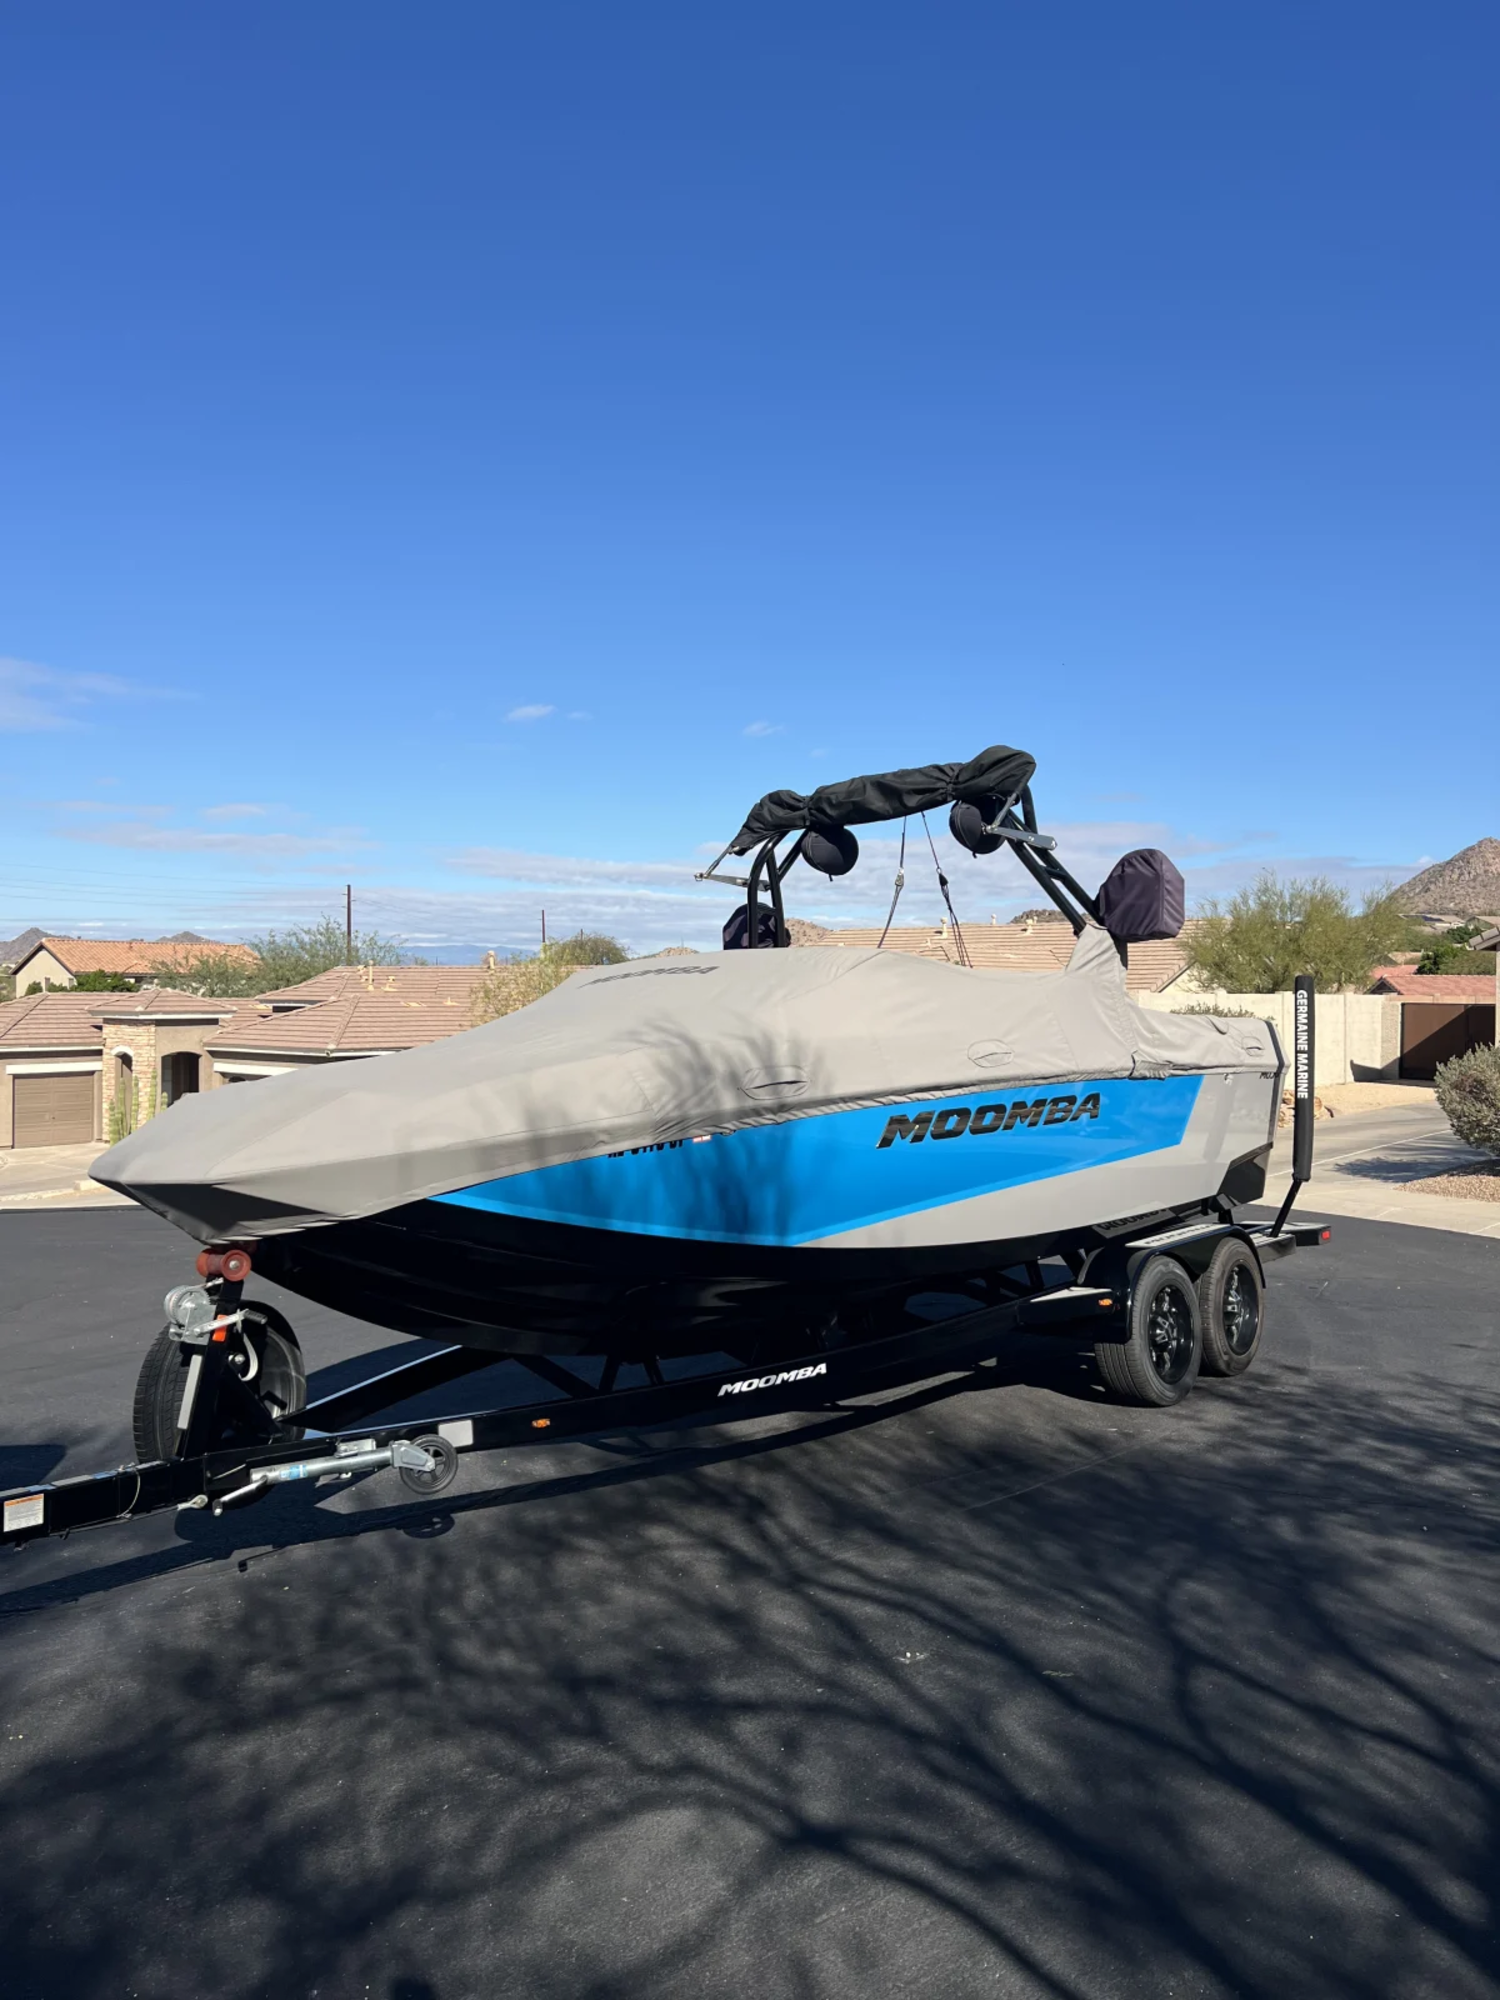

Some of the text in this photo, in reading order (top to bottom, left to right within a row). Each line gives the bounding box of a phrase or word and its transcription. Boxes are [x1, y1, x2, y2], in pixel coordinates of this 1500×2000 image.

[1297, 990, 1308, 1099] GERMAINE MARINE
[876, 1093, 1100, 1149] MOOMBA
[717, 1363, 827, 1397] MOOMBA
